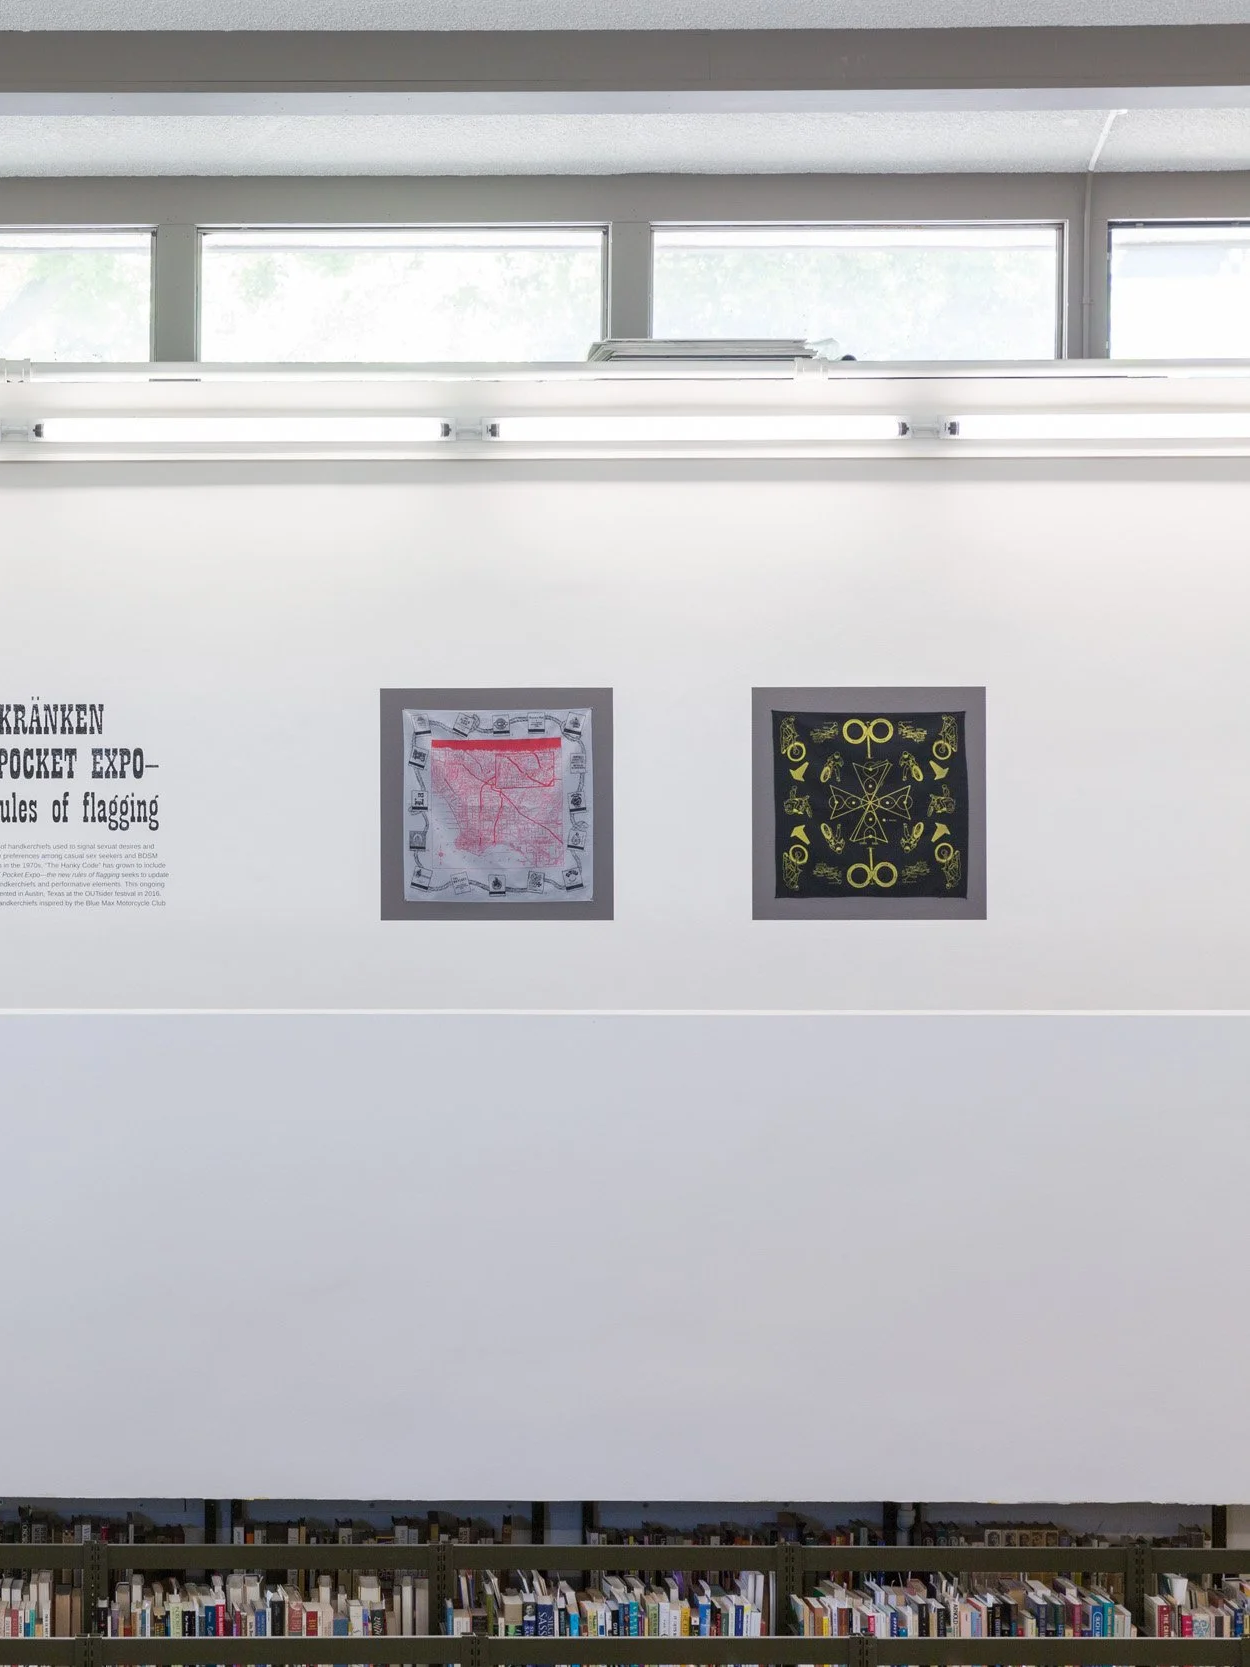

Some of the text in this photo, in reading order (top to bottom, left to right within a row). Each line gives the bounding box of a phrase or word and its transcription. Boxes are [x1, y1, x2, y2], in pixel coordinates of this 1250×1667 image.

[52, 792, 69, 823] of
[83, 792, 159, 831] flagging
[77, 843, 95, 852] signal
[3, 852, 39, 861] preferences
[61, 862, 80, 870] Hanky
[96, 871, 120, 880] flagging
[148, 871, 169, 880] update
[51, 881, 90, 889] performative
[140, 881, 165, 889] ongoing
[25, 890, 45, 899] Austin,
[39, 900, 63, 908] inspired
[65, 900, 72, 908] by
[116, 900, 150, 908] Motorcycle
